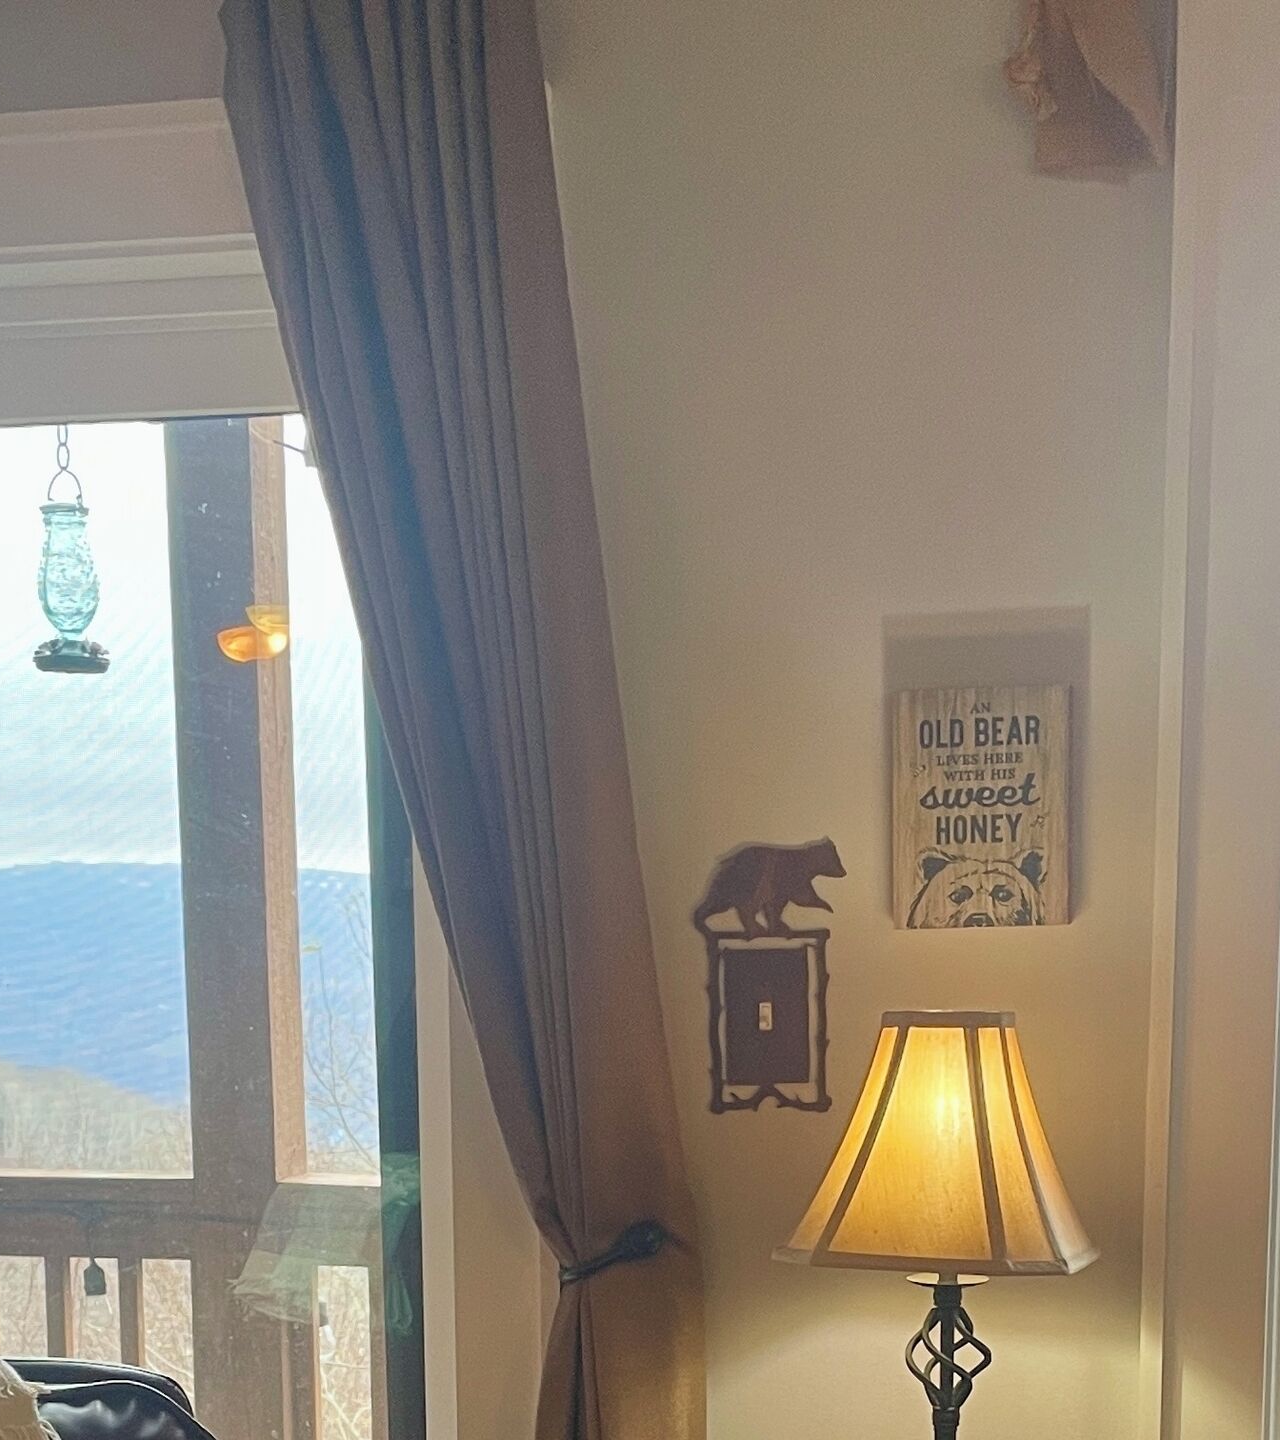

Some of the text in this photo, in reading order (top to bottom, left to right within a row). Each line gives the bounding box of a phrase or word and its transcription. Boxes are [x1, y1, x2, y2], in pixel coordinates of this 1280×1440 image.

[970, 702, 991, 714] AN
[919, 715, 1040, 749] OLD BEAR
[935, 752, 1023, 766] LIVES HERE
[944, 768, 1016, 782] WITH HIS
[919, 772, 1041, 810] sweet
[935, 813, 1023, 845] HONEY
